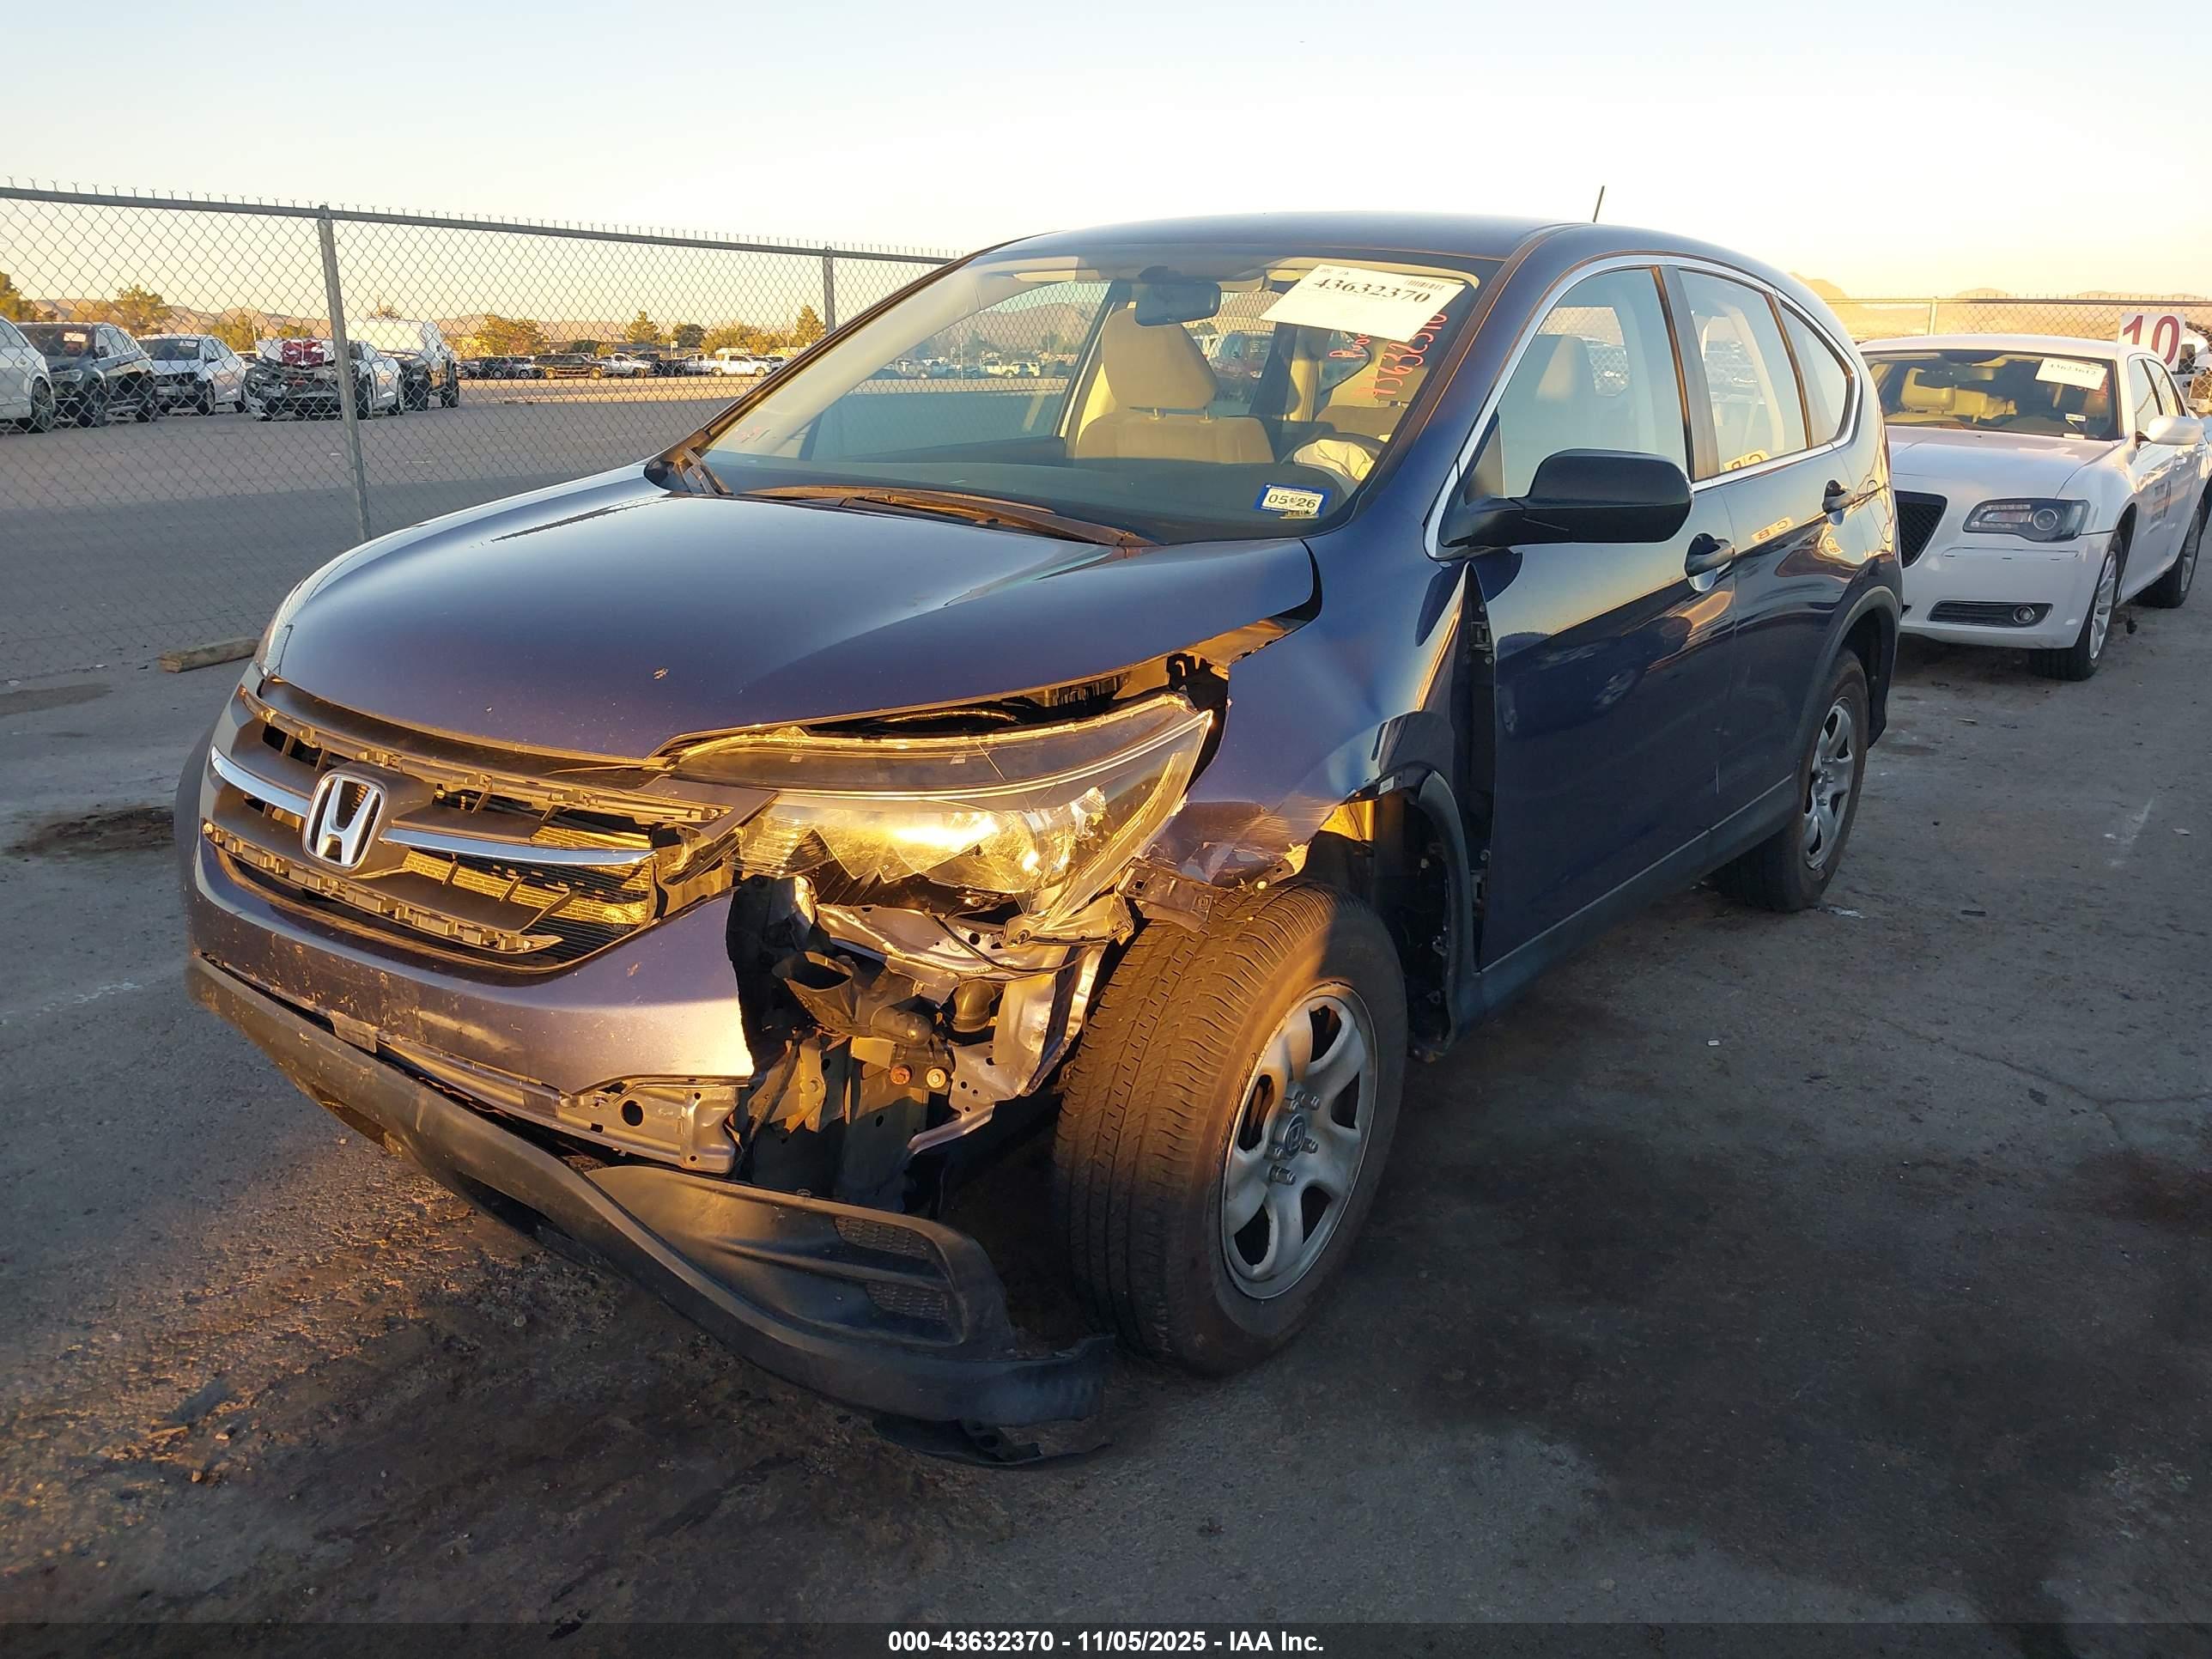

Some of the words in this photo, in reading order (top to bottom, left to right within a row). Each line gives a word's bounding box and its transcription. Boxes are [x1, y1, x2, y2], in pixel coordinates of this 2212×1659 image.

[1314, 277, 1431, 303] 43632370
[2123, 315, 2179, 365] 10
[1268, 494, 1289, 505] 05
[1296, 497, 1317, 508] 26
